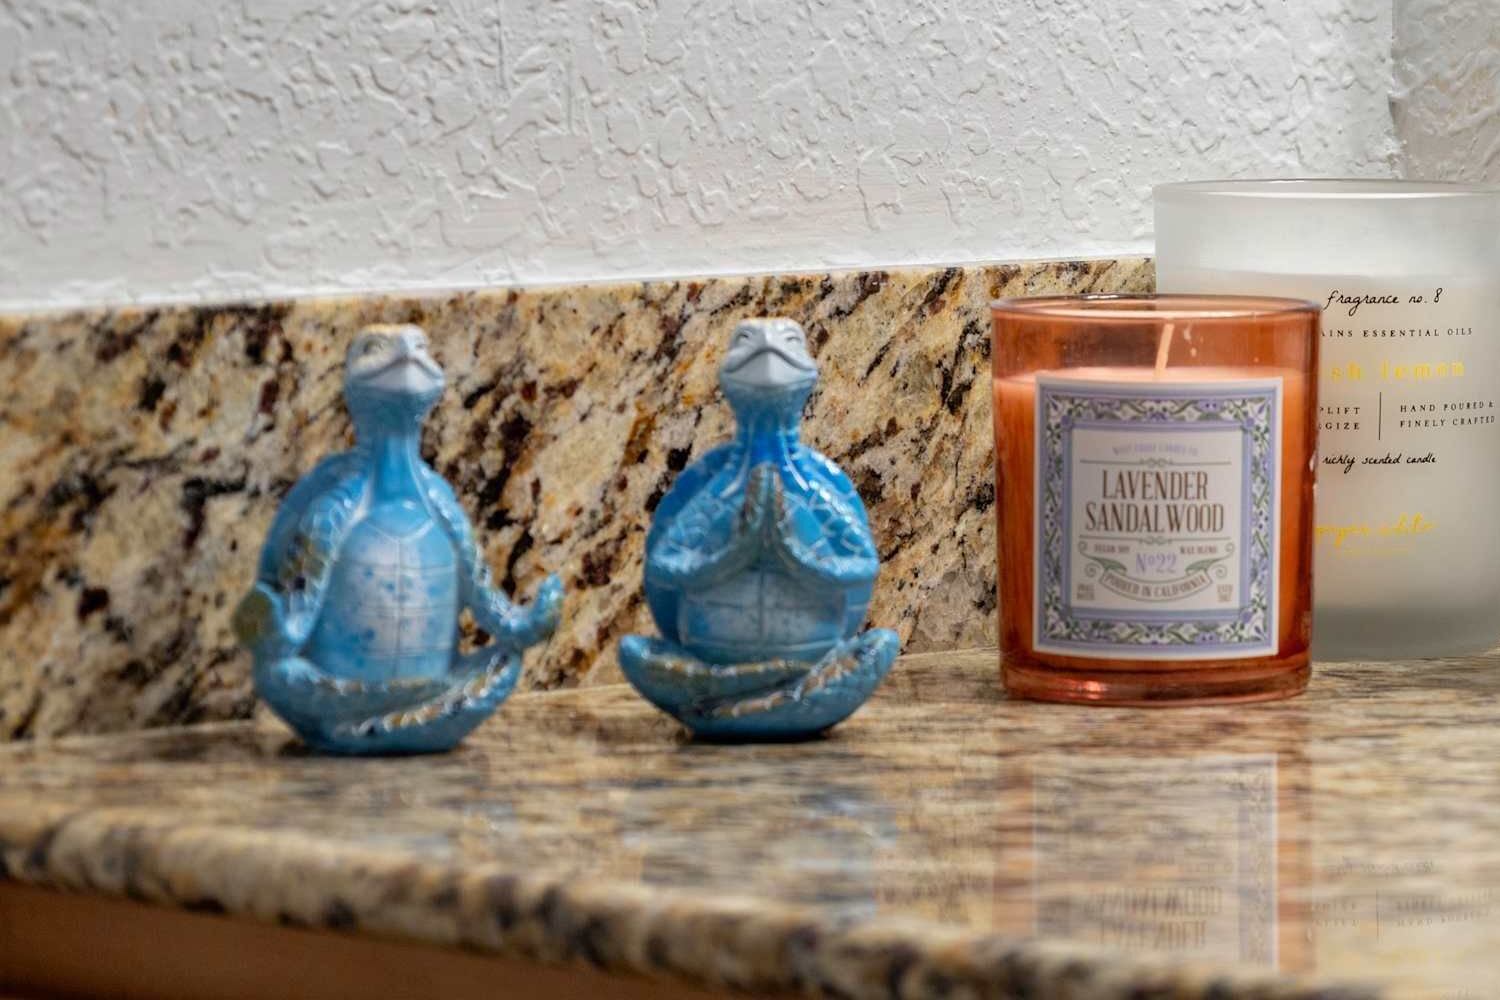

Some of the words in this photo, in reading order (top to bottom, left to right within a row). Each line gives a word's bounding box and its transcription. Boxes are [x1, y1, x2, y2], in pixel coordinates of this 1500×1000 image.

[1323, 289, 1400, 317] fragrance
[1408, 295, 1428, 304] no.
[1433, 287, 1443, 304] 8
[1363, 328, 1440, 338] ESSENTIAL
[1447, 327, 1473, 337] OILS
[1380, 359, 1465, 381] lemon
[1400, 403, 1436, 413] HAND
[1443, 400, 1485, 412] POURED
[1400, 418, 1447, 429] FINELY
[1452, 415, 1495, 427] CRAFTED
[1322, 455, 1356, 474] richly
[1361, 452, 1401, 465] scented
[1406, 452, 1437, 465] candle
[1102, 469, 1209, 501] LAVENDER
[1085, 502, 1225, 534] SANDALWOOD
[1103, 571, 1141, 596] POURED
[1141, 584, 1151, 597] IN
[1153, 576, 1208, 597] CALIFORNIA
